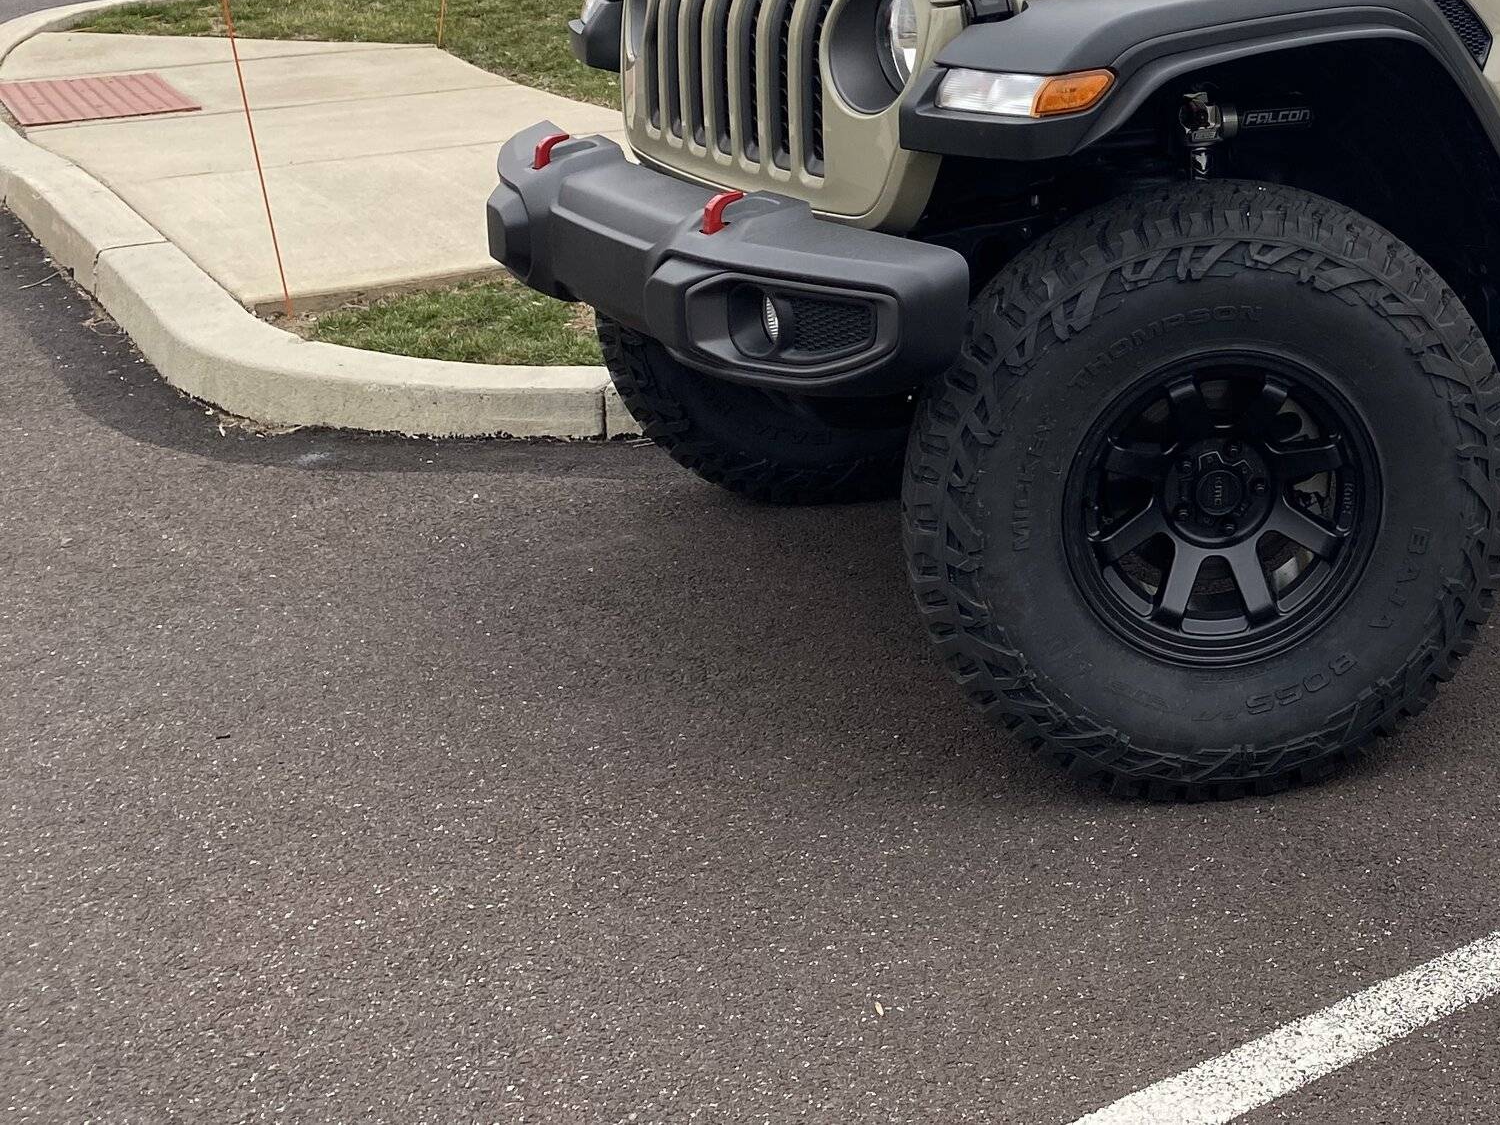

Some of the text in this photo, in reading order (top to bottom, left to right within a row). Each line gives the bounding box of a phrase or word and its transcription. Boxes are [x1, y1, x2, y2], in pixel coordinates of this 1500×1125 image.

[1245, 109, 1310, 125] FALCON
[1067, 305, 1263, 385] THOMPSON
[1245, 652, 1358, 715] BOSS
